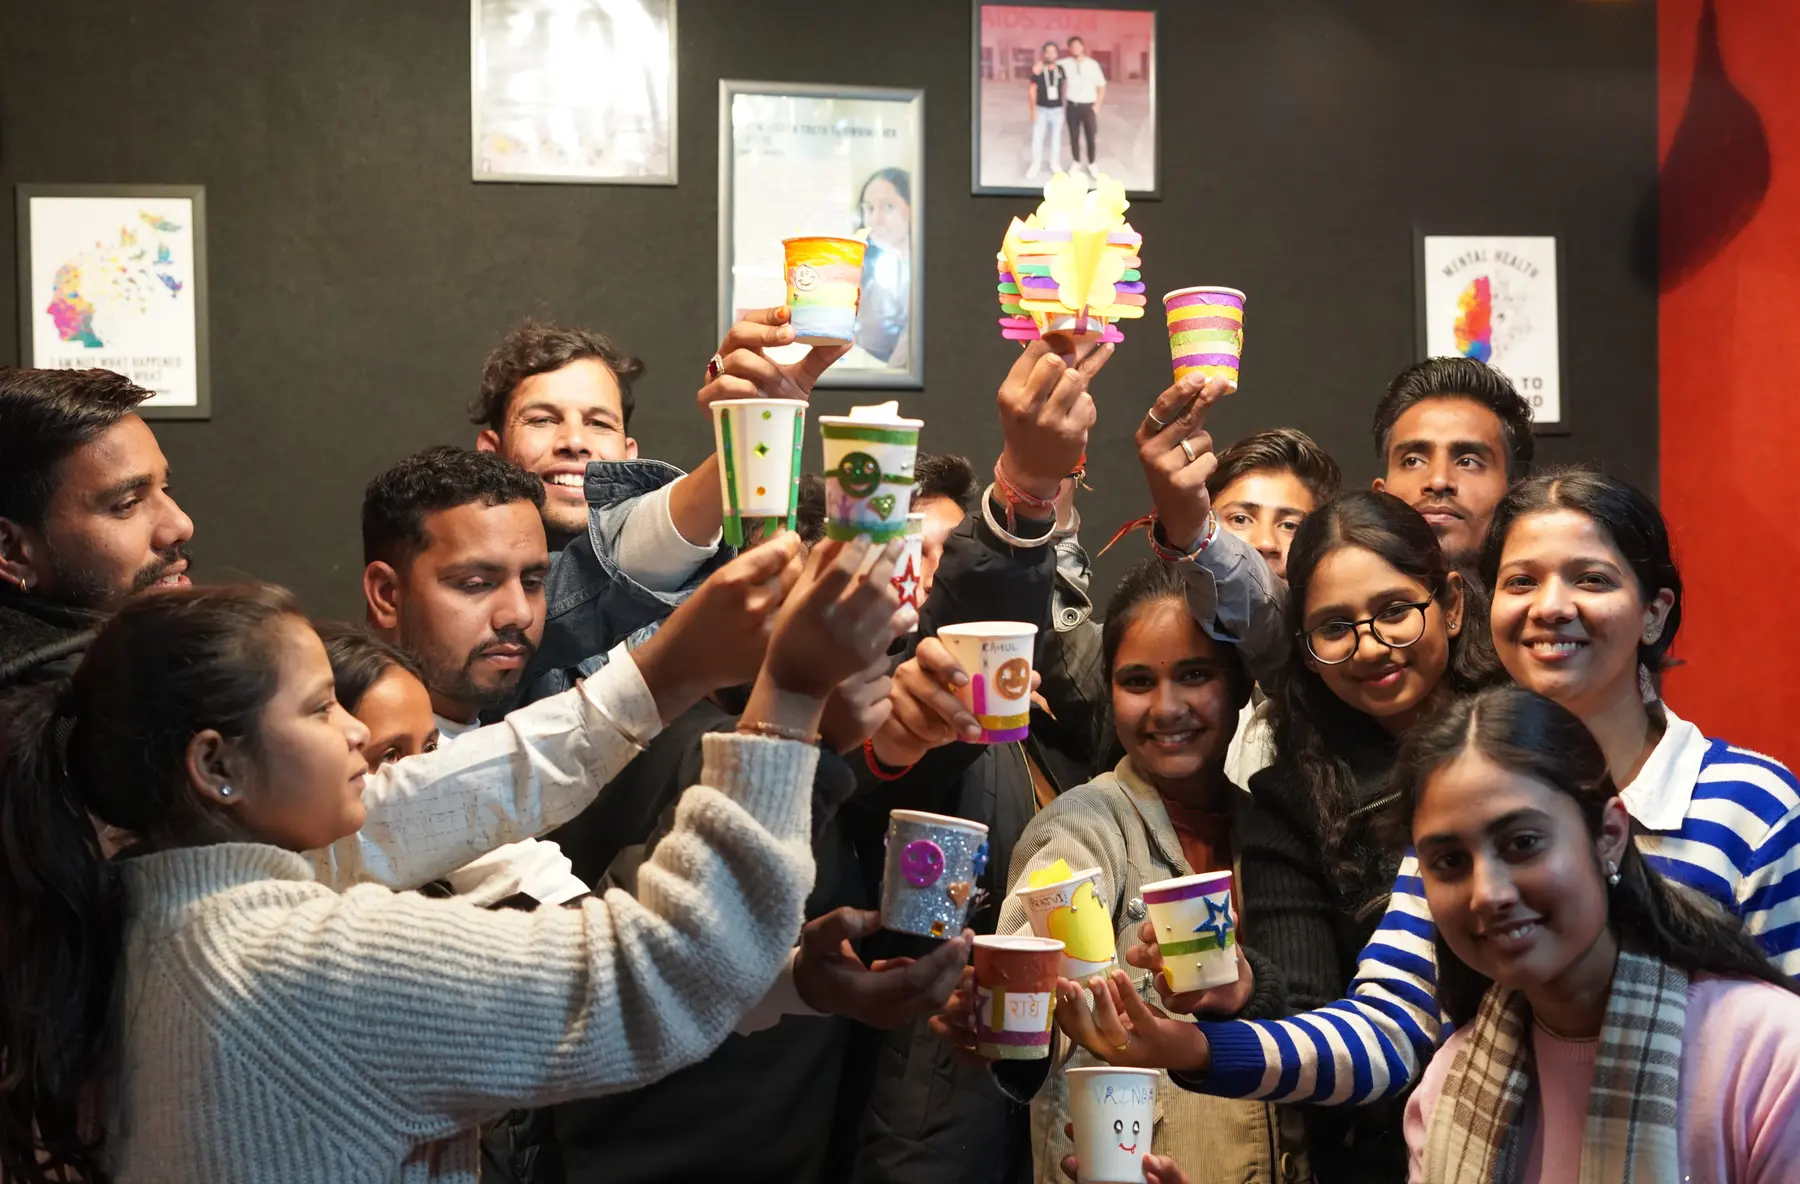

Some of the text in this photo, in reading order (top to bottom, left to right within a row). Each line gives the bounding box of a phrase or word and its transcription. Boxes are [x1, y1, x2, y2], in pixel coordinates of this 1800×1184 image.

[1442, 249, 1539, 279] MENTAL HEALTH
[100, 356, 127, 367] WHAT
[1522, 377, 1543, 390] TO
